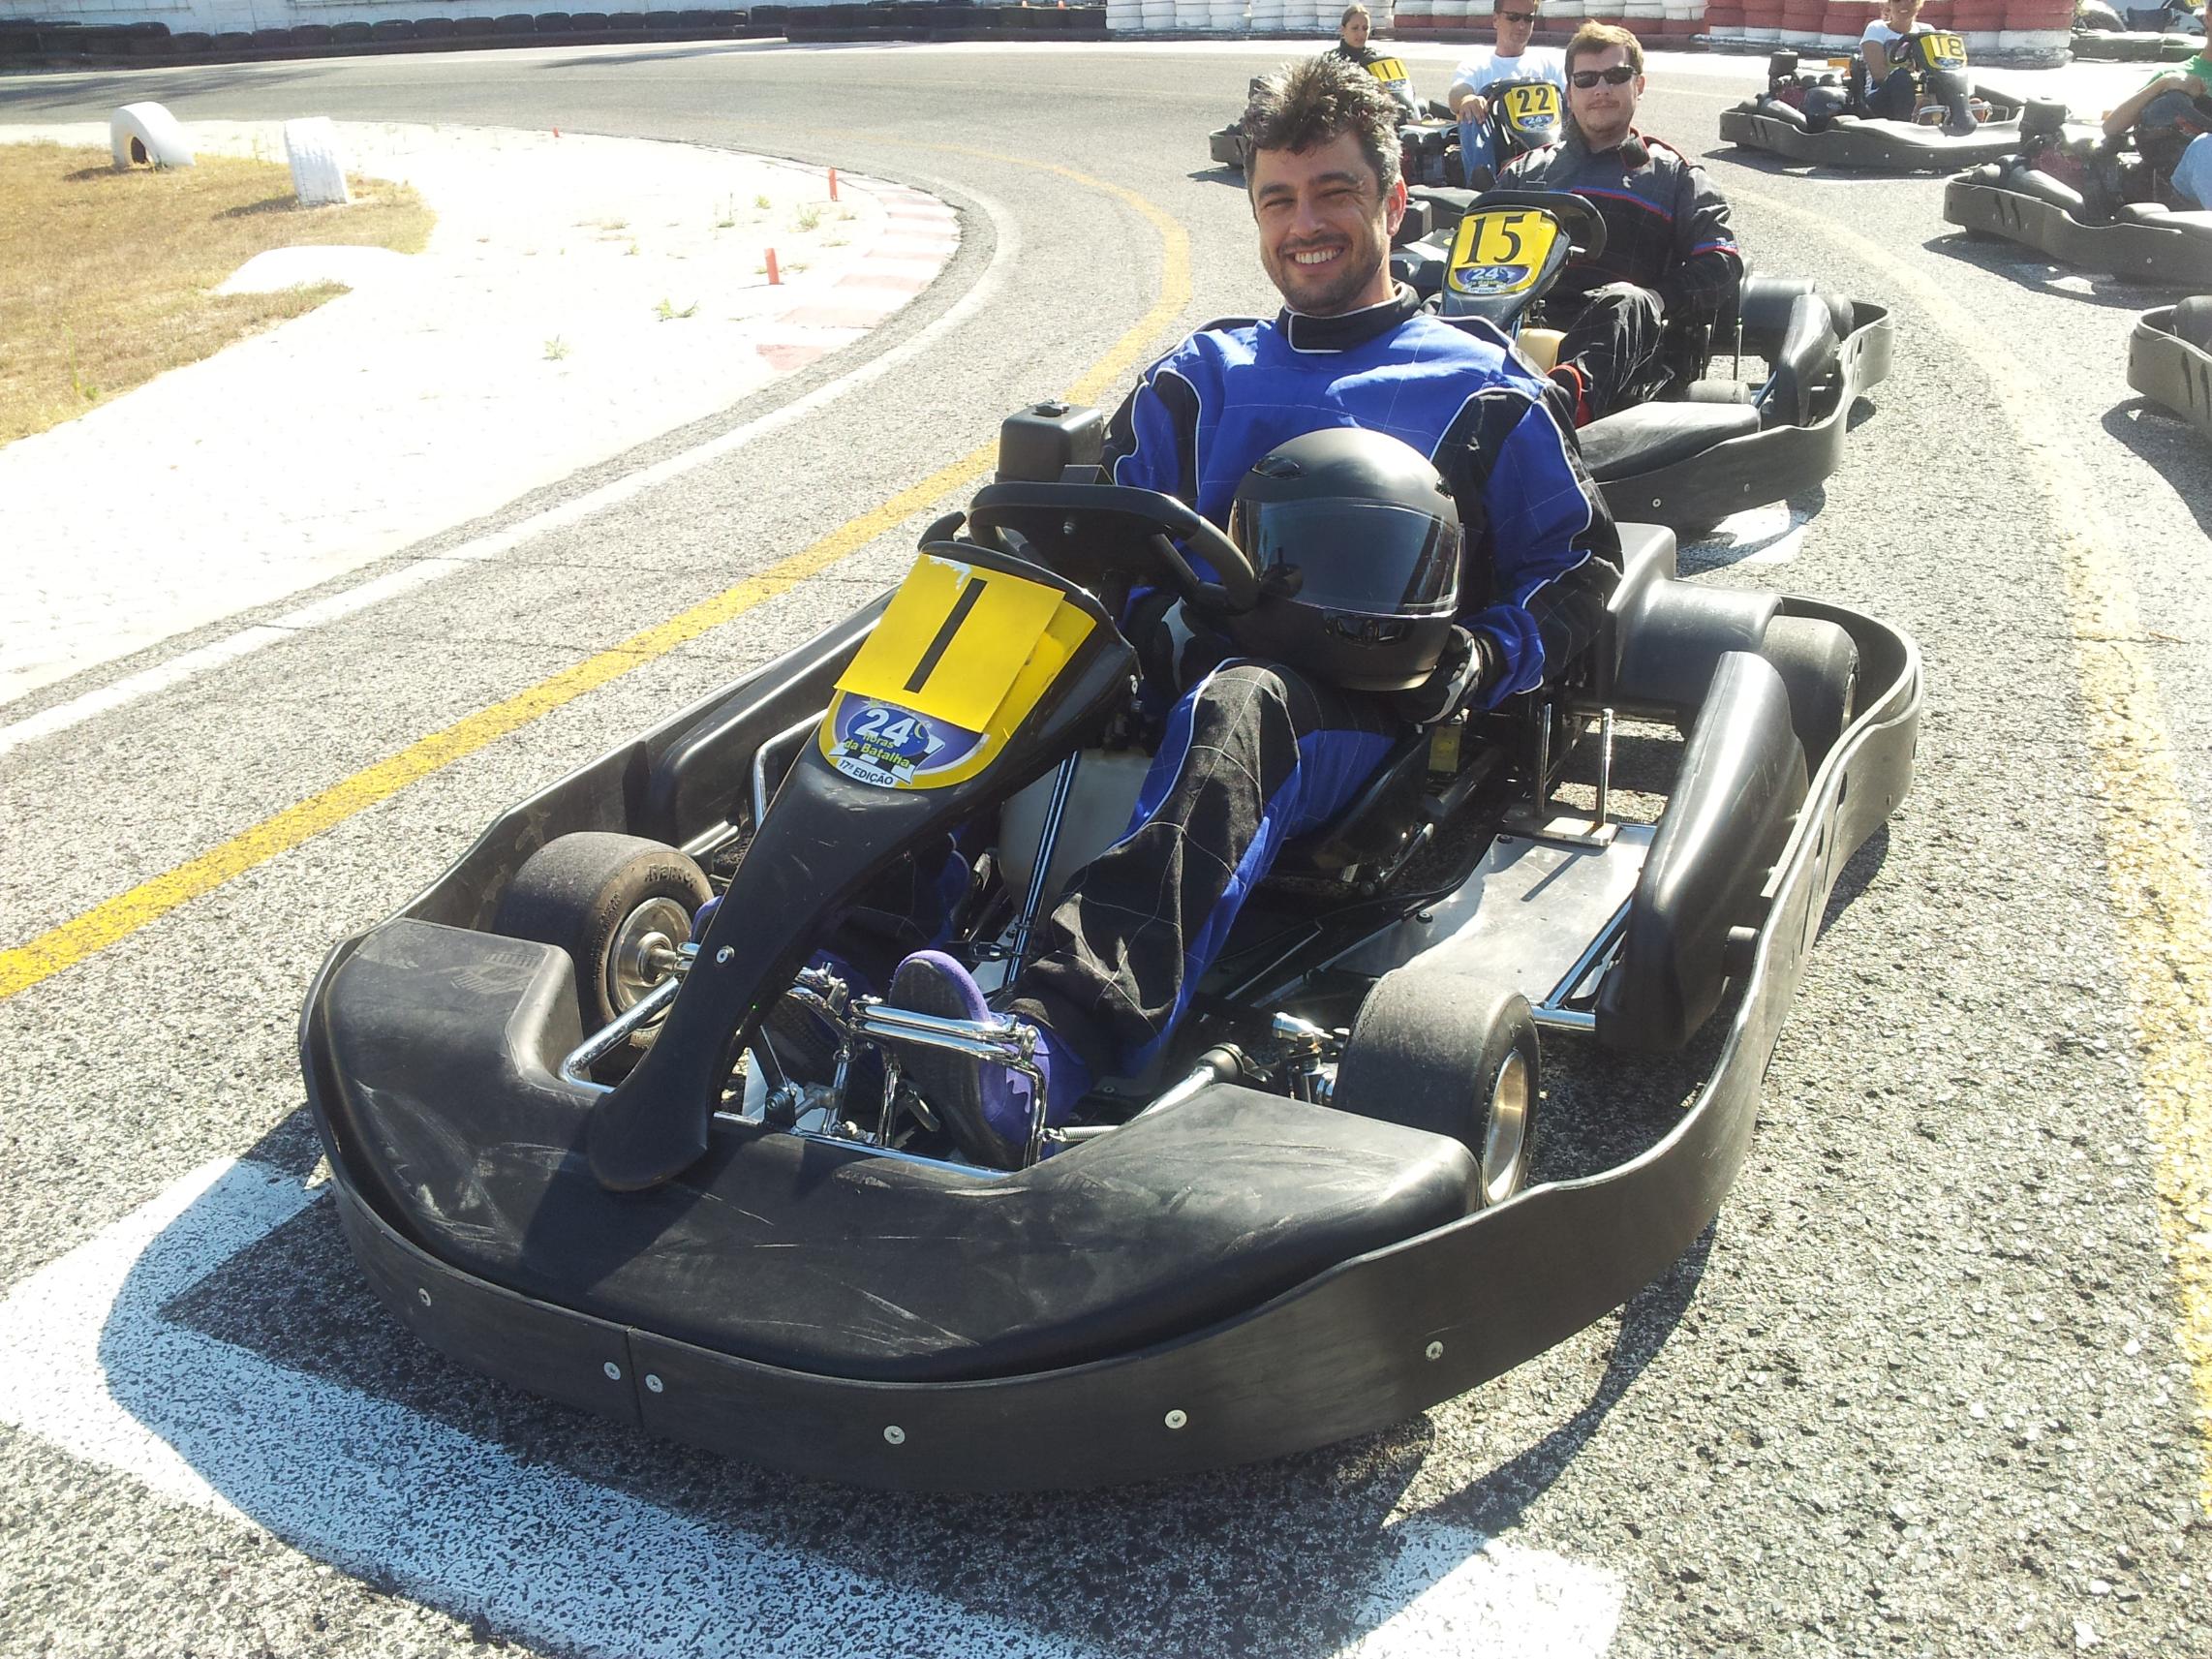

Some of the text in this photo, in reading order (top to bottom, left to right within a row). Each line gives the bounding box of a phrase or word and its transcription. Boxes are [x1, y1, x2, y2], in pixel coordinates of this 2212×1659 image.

[1935, 37, 1964, 56] 18
[1382, 61, 1404, 79] 11
[1517, 87, 1551, 112] 22
[1462, 214, 1525, 264] 15
[1471, 267, 1499, 279] 24
[903, 577, 988, 693] 1
[854, 709, 915, 747] 24
[863, 732, 895, 750] horas
[845, 740, 910, 769] da Batalha
[854, 767, 894, 785] EDIÇÃO
